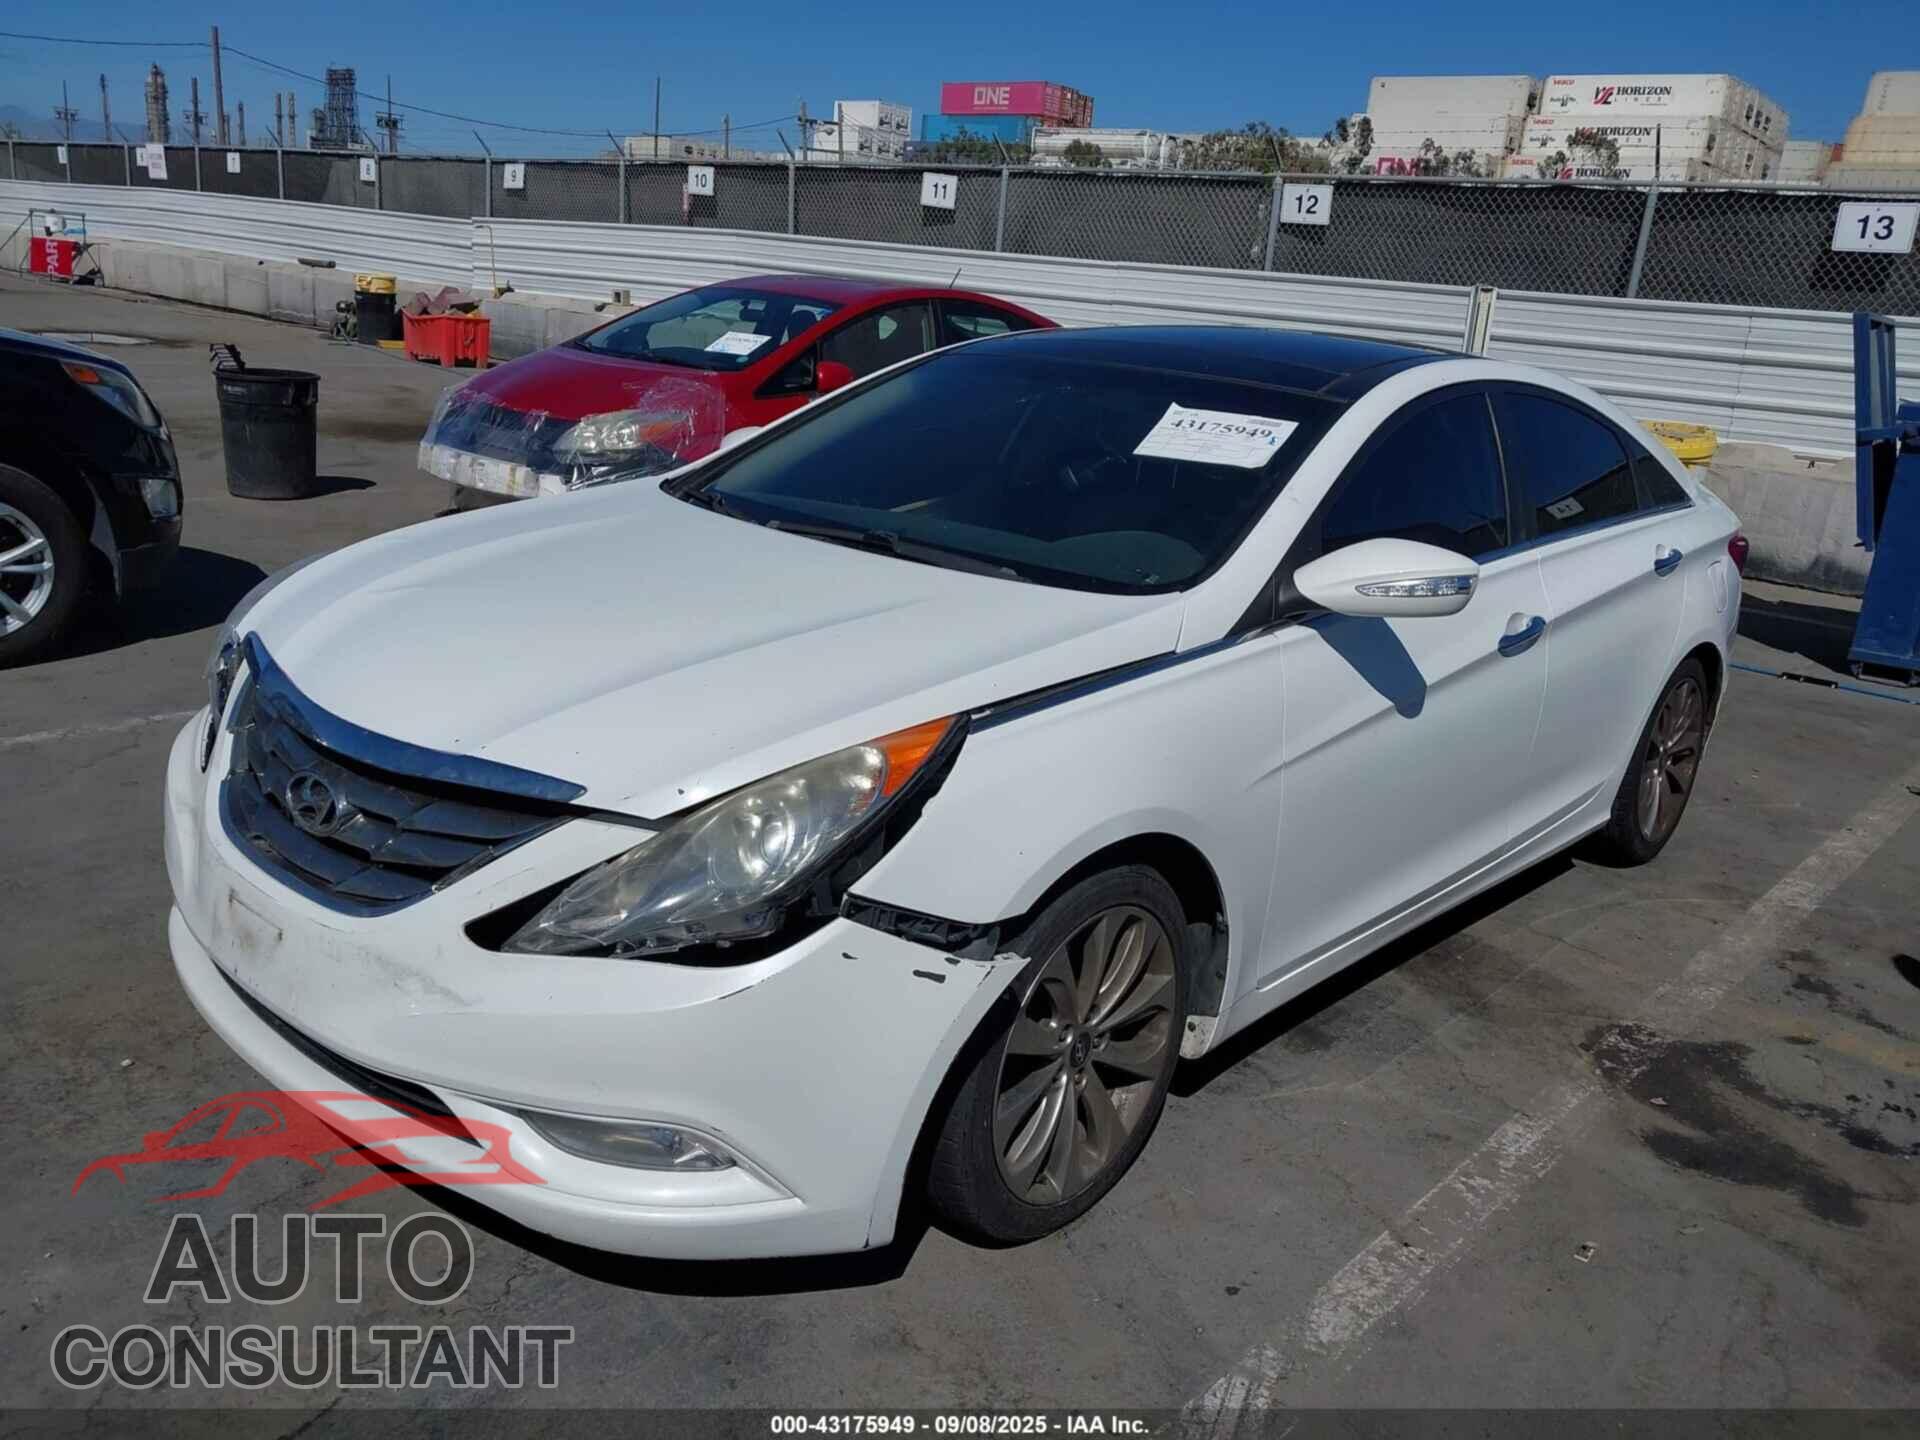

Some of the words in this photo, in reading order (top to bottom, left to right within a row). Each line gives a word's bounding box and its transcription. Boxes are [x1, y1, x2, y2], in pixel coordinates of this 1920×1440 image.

[973, 86, 1010, 105] ONE
[1616, 86, 1672, 96] HORIZON
[1597, 127, 1652, 137] HORIZON
[511, 169, 518, 183] 9
[695, 173, 708, 188] 10
[932, 182, 947, 199] 11
[1295, 193, 1319, 215] 12
[1856, 214, 1895, 241] 13
[1170, 418, 1273, 438] 43175949
